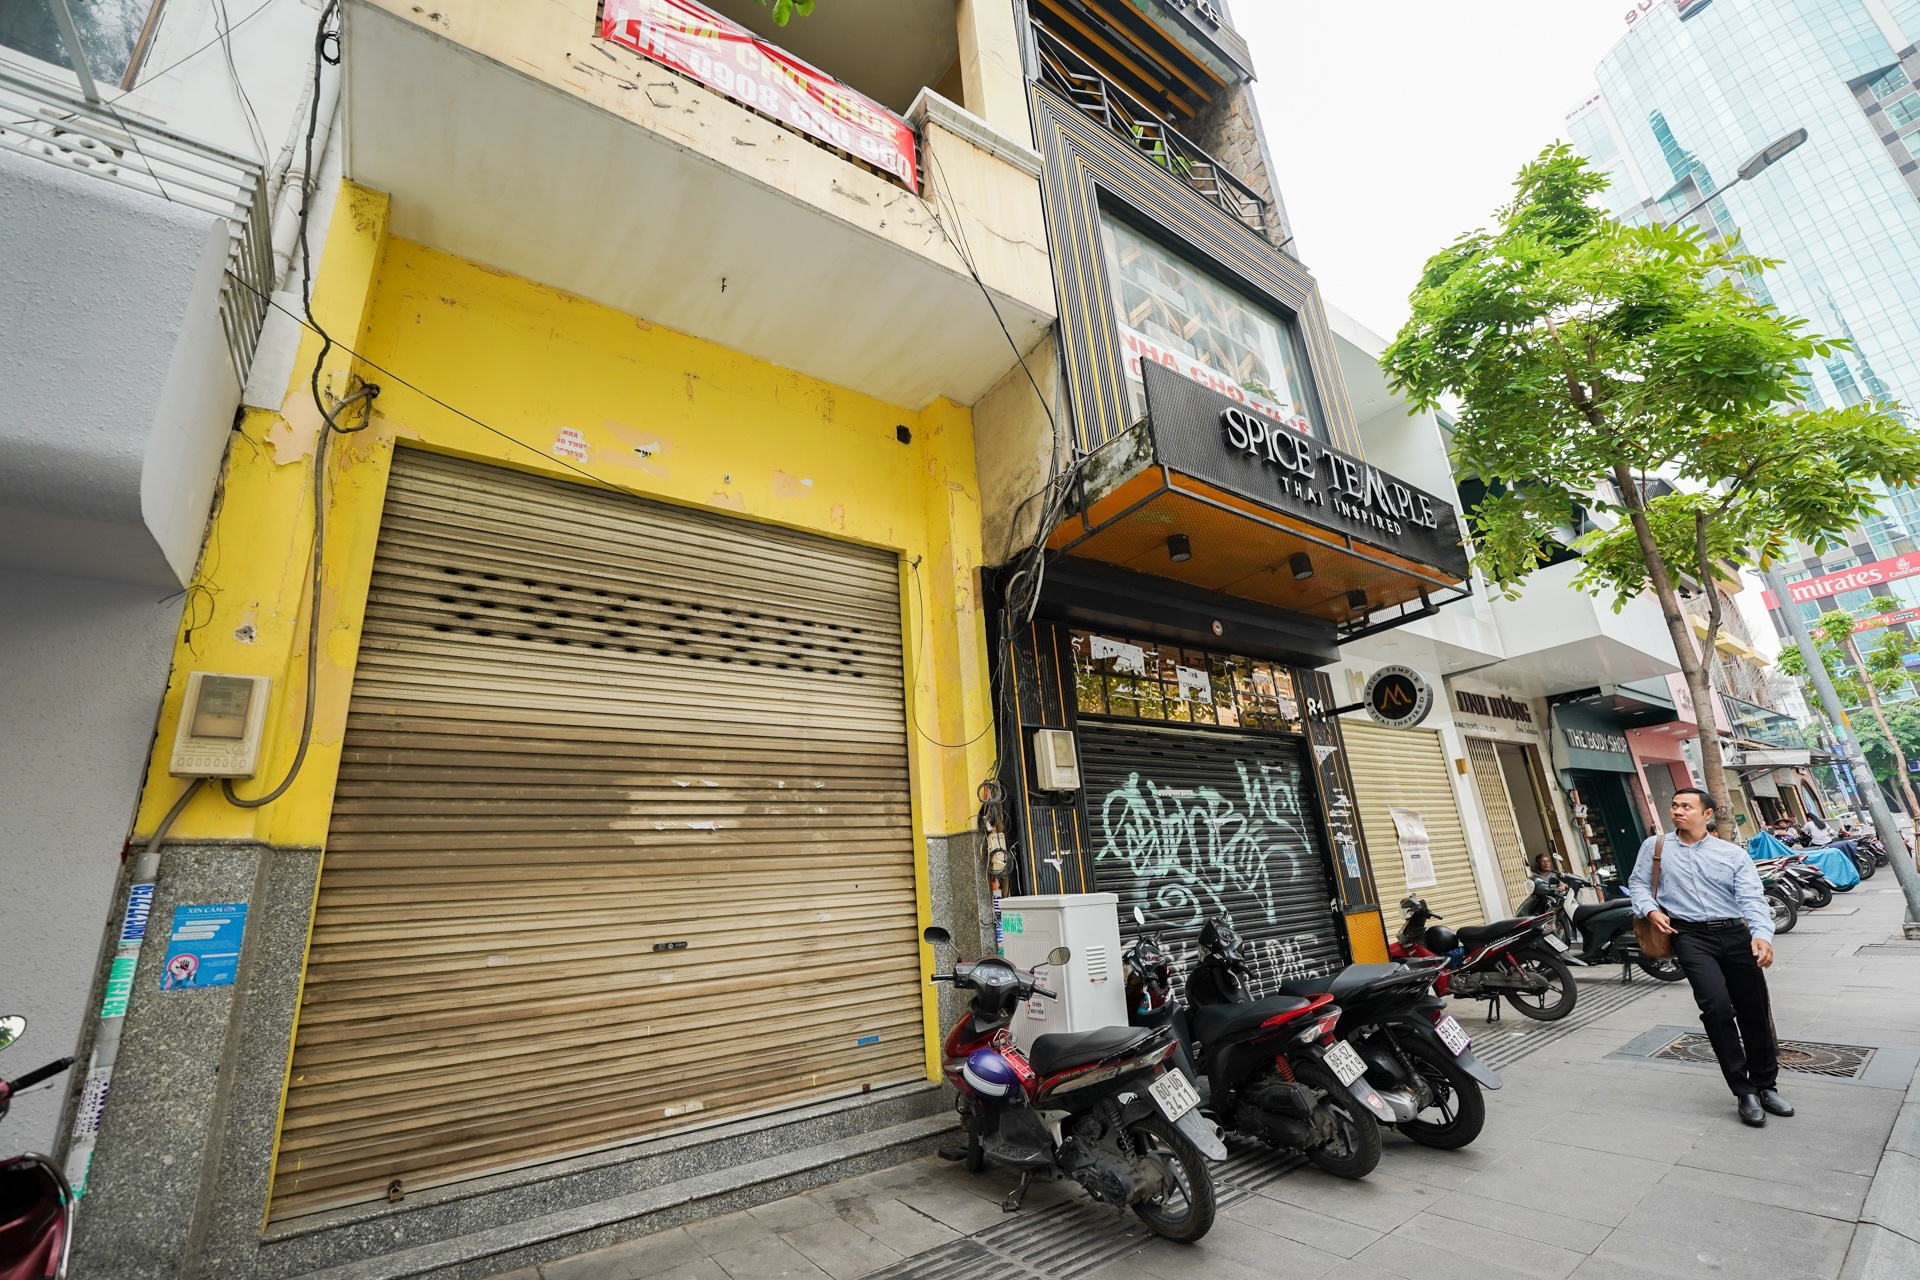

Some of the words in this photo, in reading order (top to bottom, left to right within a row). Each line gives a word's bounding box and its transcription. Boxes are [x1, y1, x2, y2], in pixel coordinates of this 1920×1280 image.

[615, 9, 676, 63] LH:
[690, 50, 778, 113] 0908
[736, 44, 807, 97] CHO
[1565, 94, 1600, 120] CHU
[1190, 366, 1245, 404] CHO
[1222, 406, 1316, 480] SPICE
[1316, 448, 1438, 530] TEMPLE
[1280, 476, 1324, 506] THAI
[1333, 498, 1402, 536] INSPIRED
[1788, 568, 1883, 602] mirates
[1366, 672, 1382, 697] SPICE
[1386, 666, 1420, 683] TEMPLE
[1371, 709, 1390, 726] THAI
[1394, 696, 1425, 727] INSPIRED
[1565, 728, 1586, 749] THE
[1586, 732, 1609, 752] BODY
[1608, 735, 1630, 754] SHOP
[1337, 1056, 1364, 1084] 778.19
[1155, 1073, 1184, 1100] 60-U6
[1165, 1087, 1195, 1116] 3411
